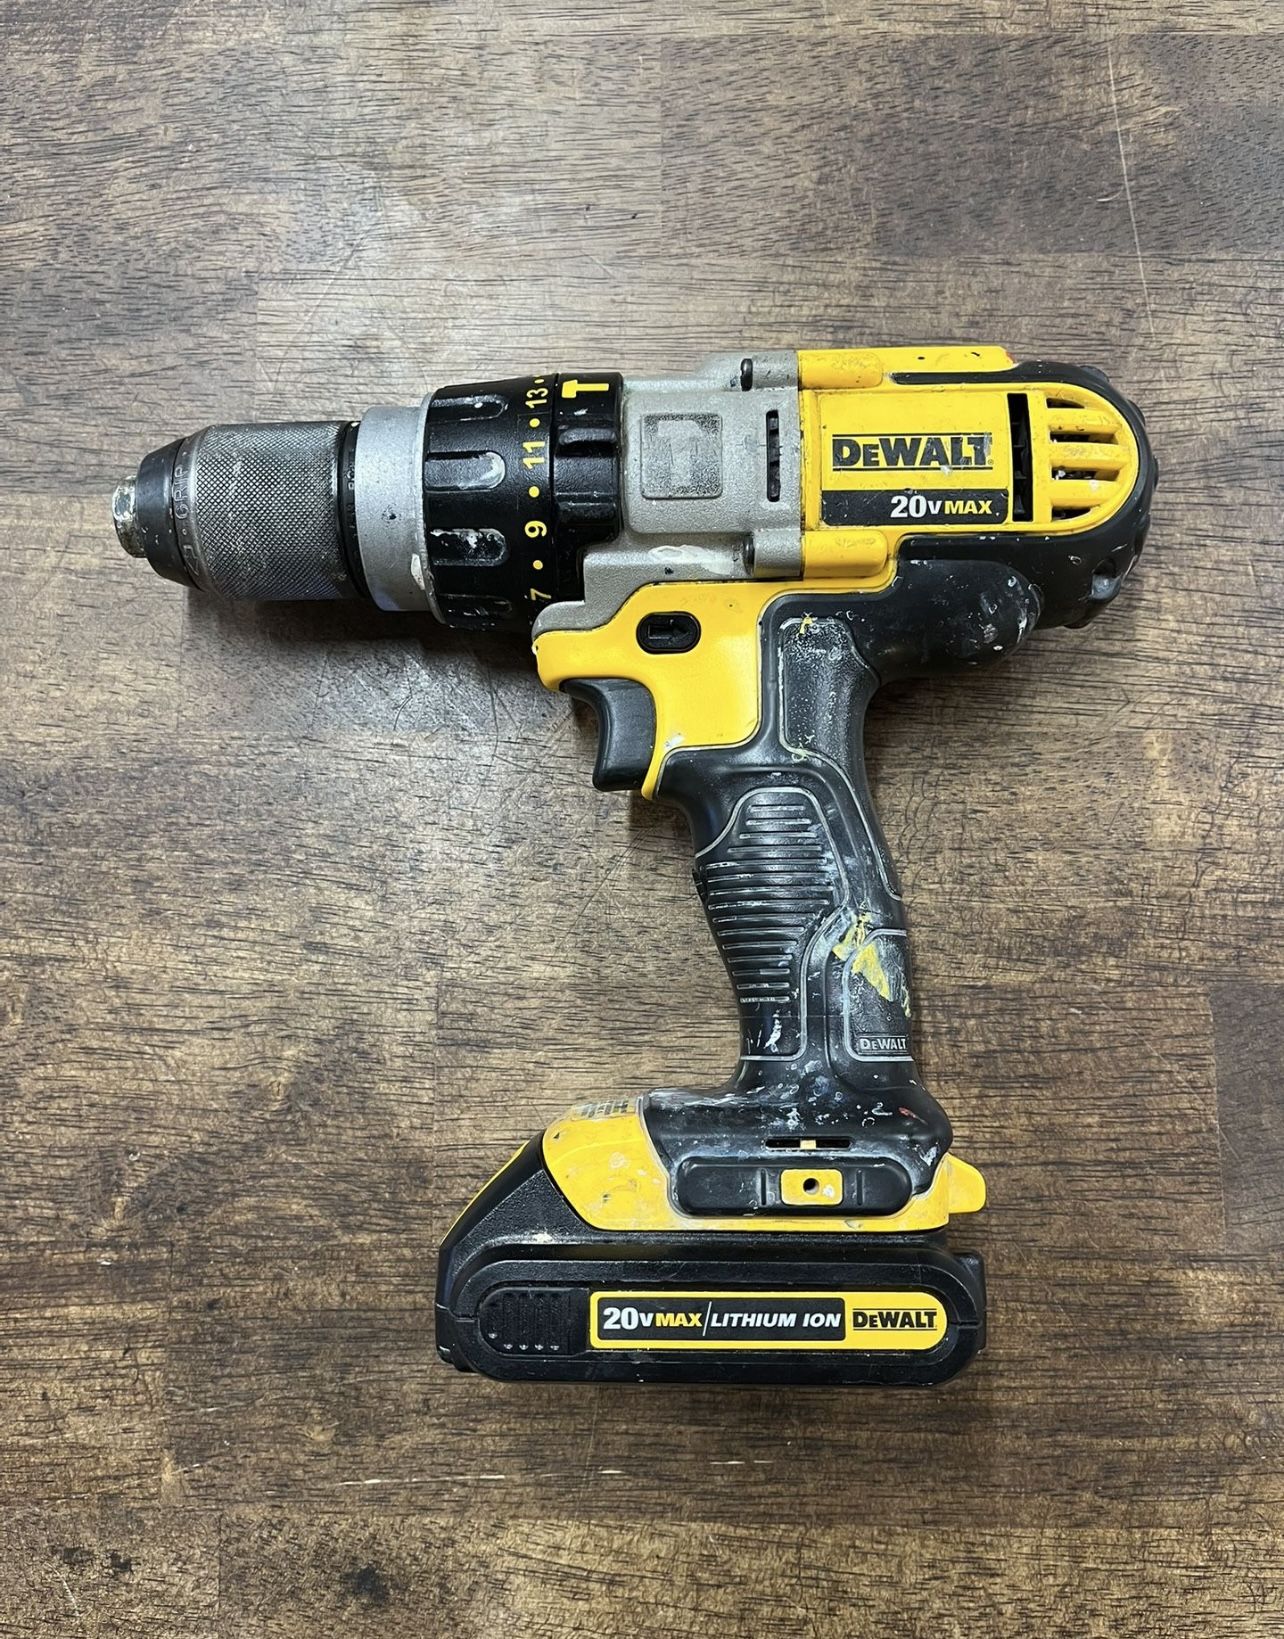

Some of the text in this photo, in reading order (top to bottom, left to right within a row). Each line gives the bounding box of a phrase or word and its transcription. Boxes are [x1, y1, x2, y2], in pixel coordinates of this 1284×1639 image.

[833, 438, 990, 467] DEWALT
[523, 388, 551, 600] 7 9 11 13
[860, 1038, 906, 1049] DEWALT
[711, 1311, 795, 1328] LITHIUM
[803, 1311, 842, 1328] ION
[853, 1312, 937, 1329] DEWALT
